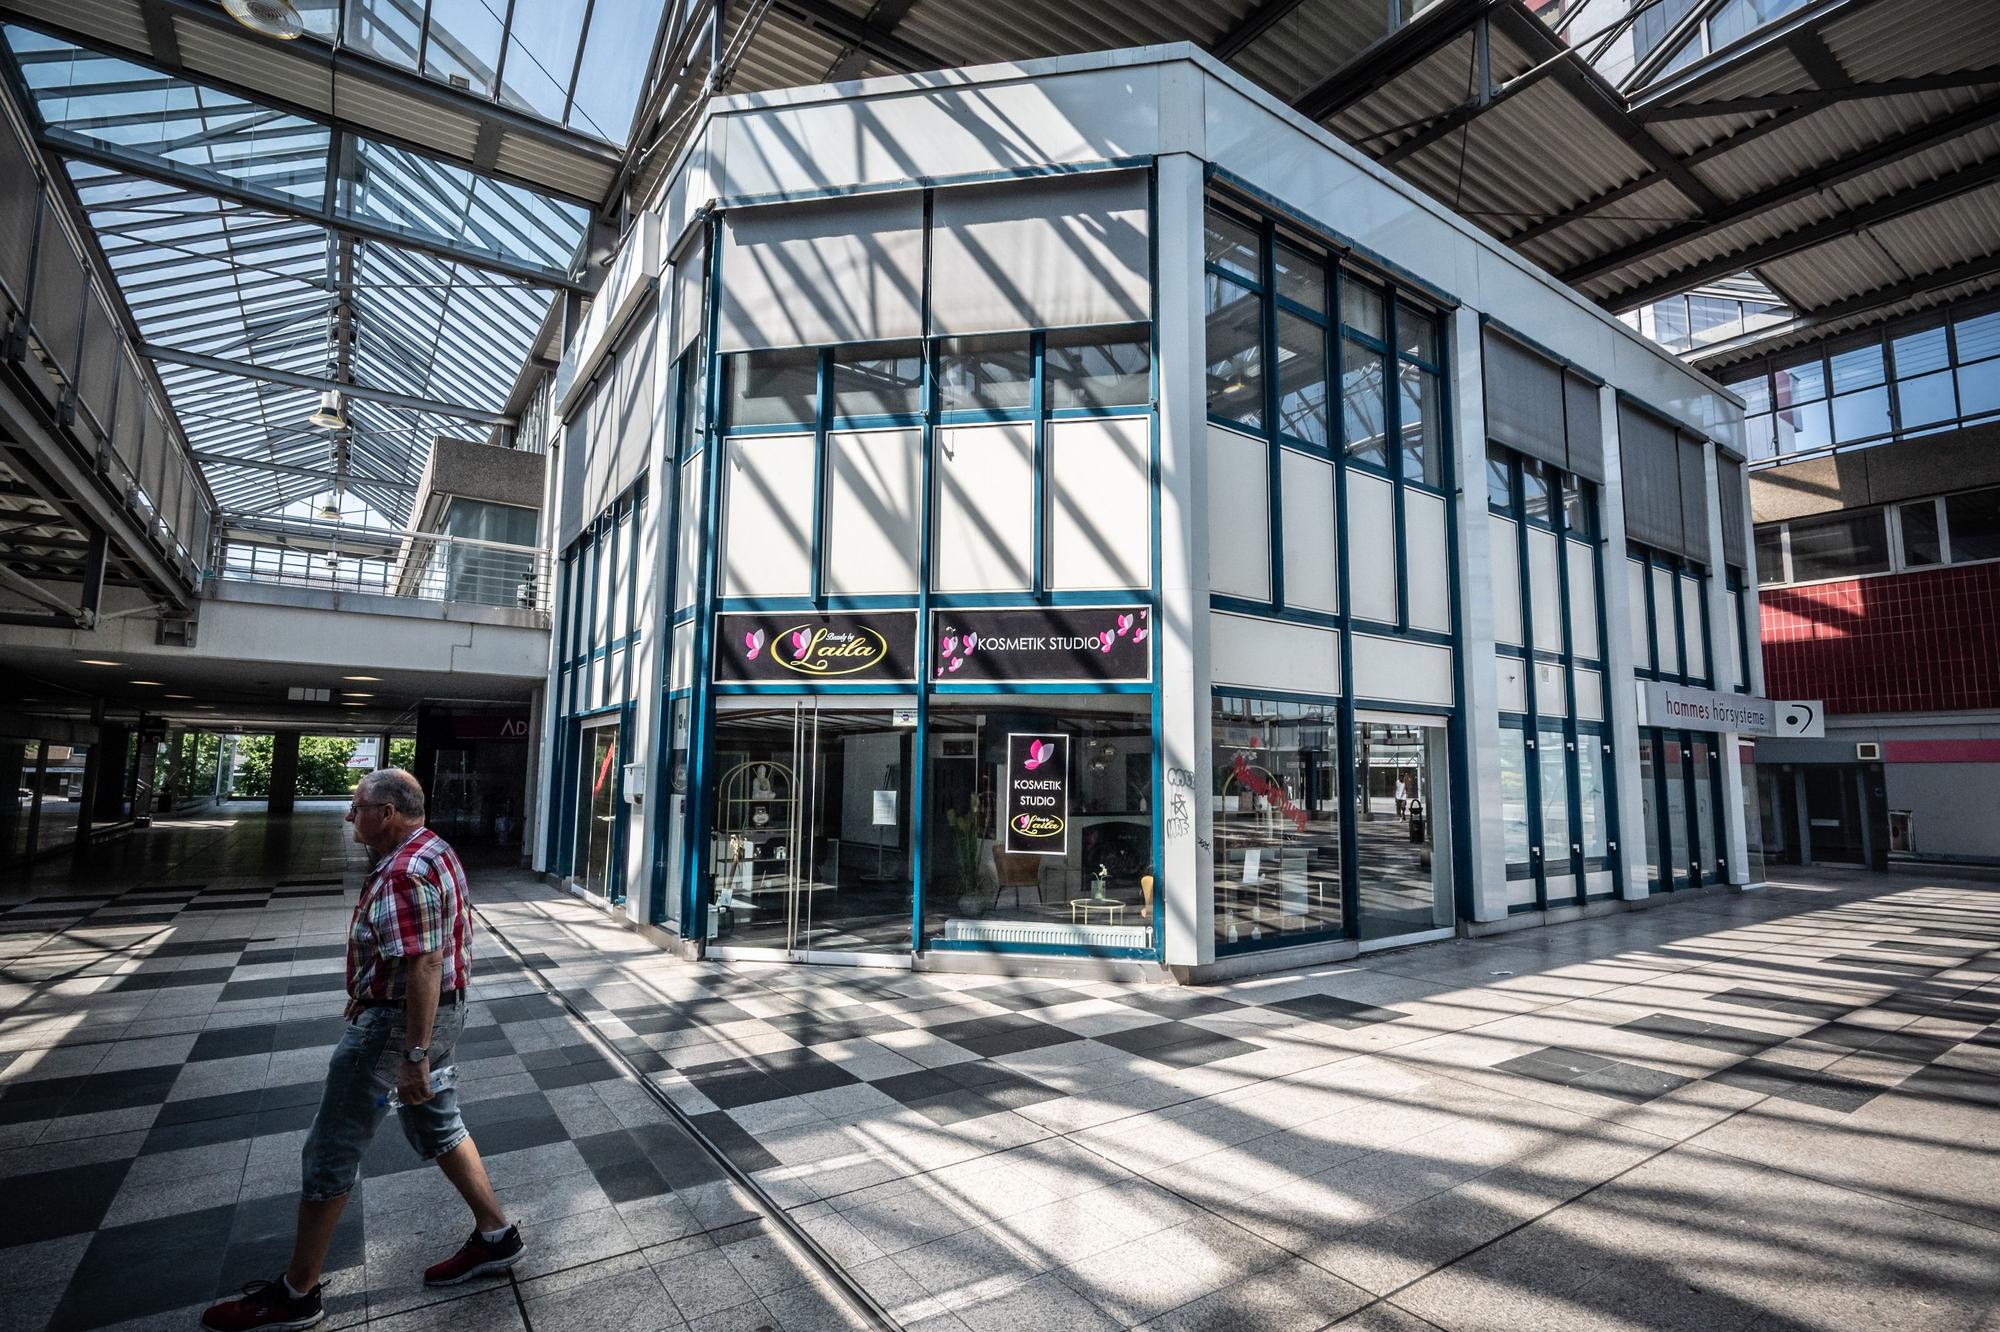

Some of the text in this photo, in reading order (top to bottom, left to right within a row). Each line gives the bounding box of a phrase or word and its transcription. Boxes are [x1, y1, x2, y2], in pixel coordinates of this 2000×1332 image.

[826, 632, 855, 642] Beauty by
[977, 636, 1101, 651] KOSMETIK STUDIO
[790, 627, 876, 670] Laila
[1665, 690, 1765, 728] hammes hörsysteme
[1014, 779, 1062, 791] KOSMETIK
[1020, 795, 1056, 806] STUDIO
